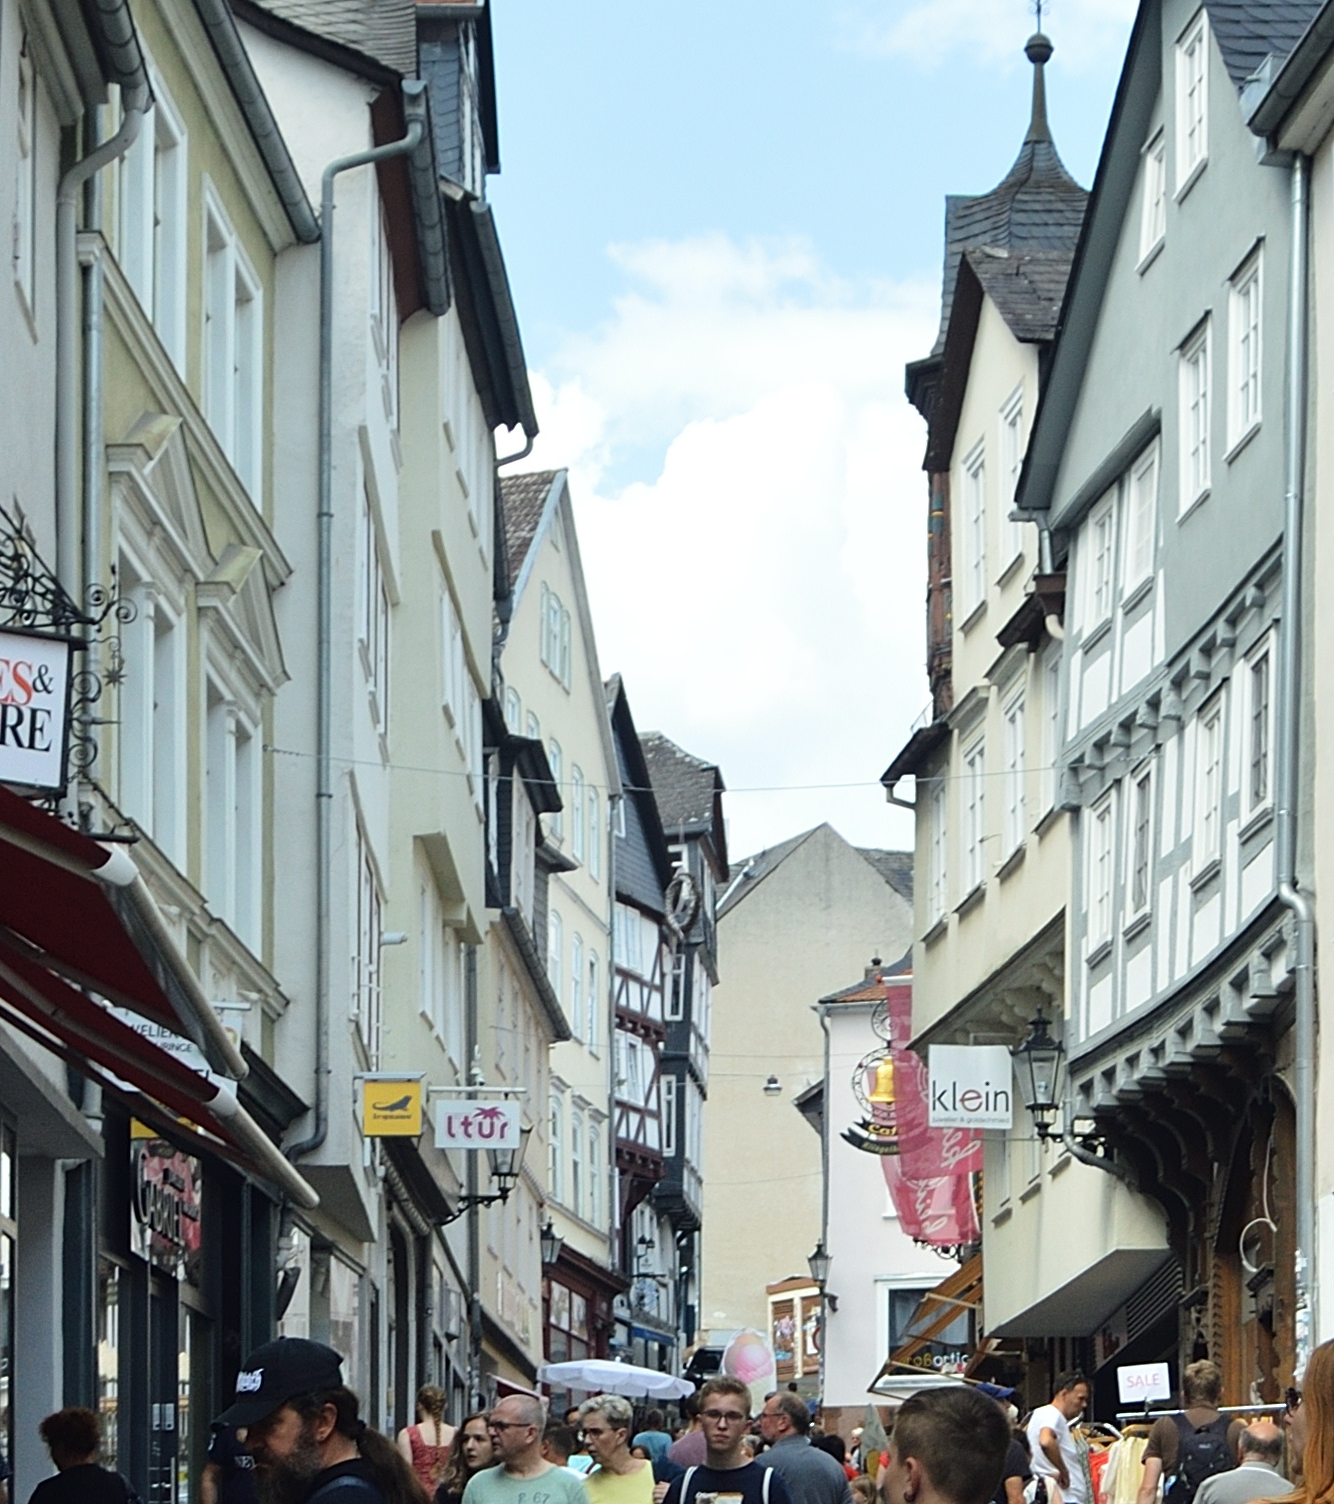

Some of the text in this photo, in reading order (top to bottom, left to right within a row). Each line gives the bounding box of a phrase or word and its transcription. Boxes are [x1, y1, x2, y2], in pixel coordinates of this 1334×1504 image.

[32, 664, 54, 694] &
[933, 1080, 1009, 1112] klein
[1127, 1373, 1160, 1388] SALE
